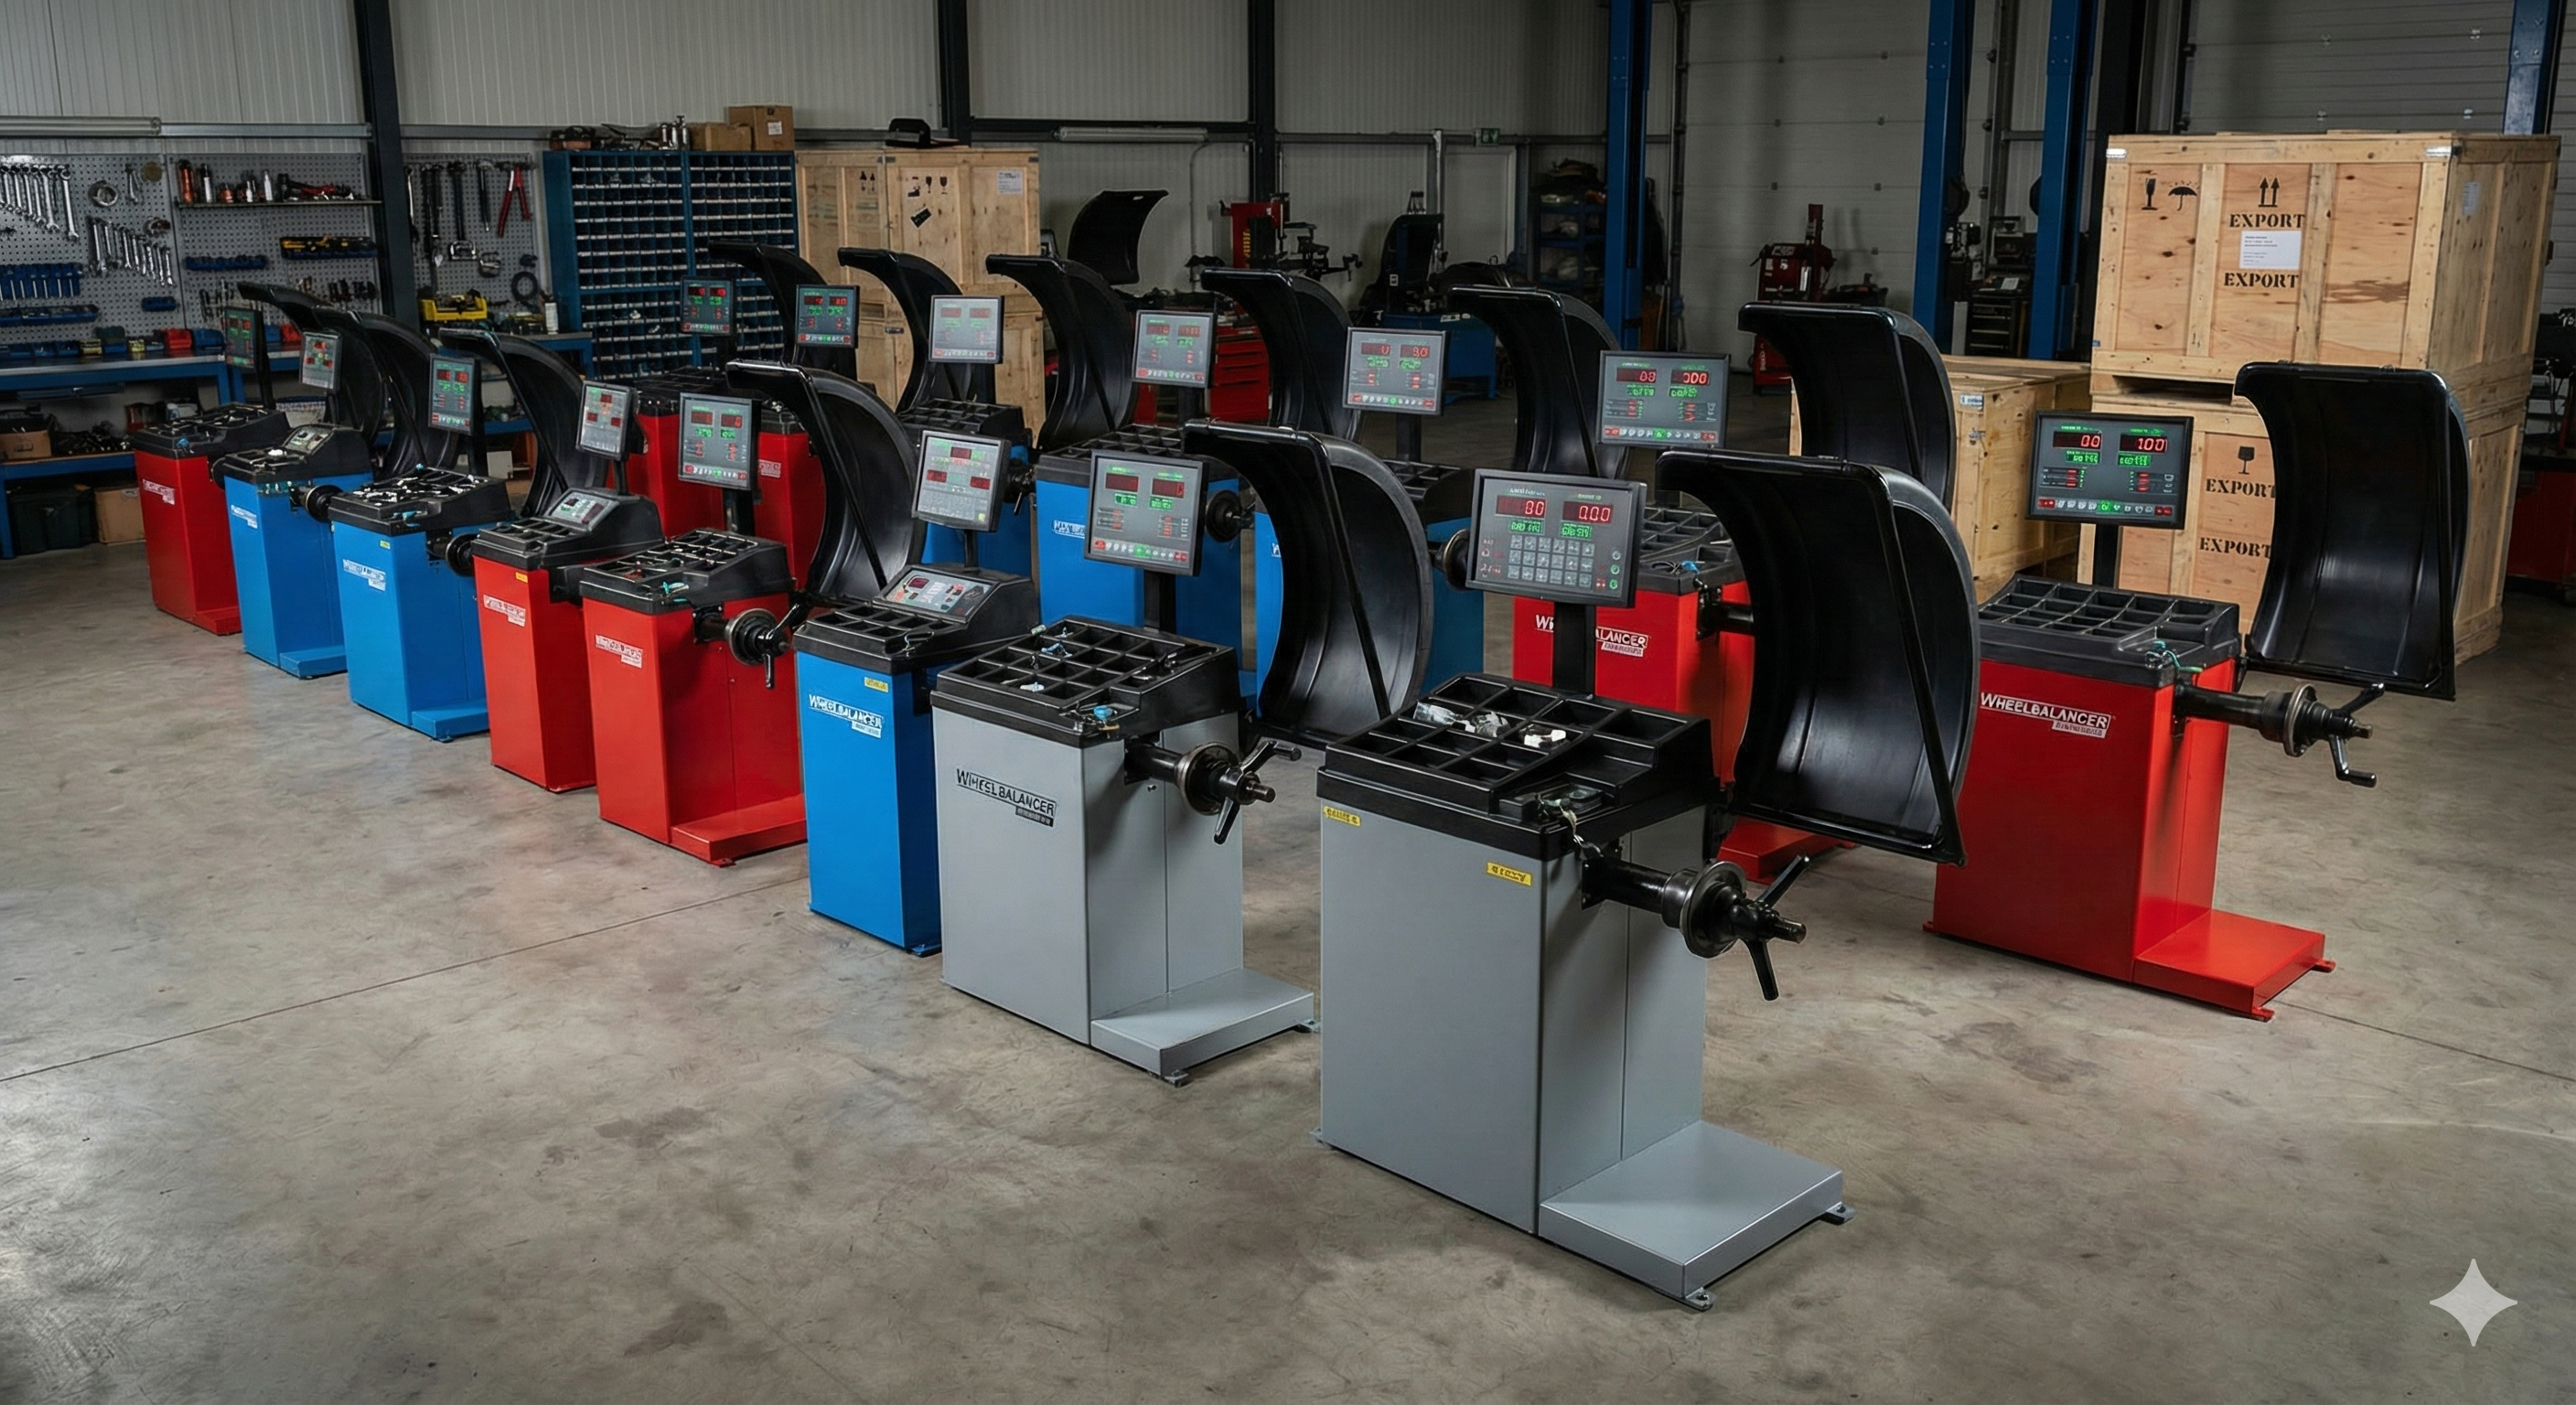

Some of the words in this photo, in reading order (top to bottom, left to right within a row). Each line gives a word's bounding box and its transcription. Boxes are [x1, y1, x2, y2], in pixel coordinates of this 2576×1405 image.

[2229, 213, 2305, 228] EXPORT
[2224, 273, 2299, 288] EXPORT
[1980, 692, 2108, 728] WHEELBALANCER
